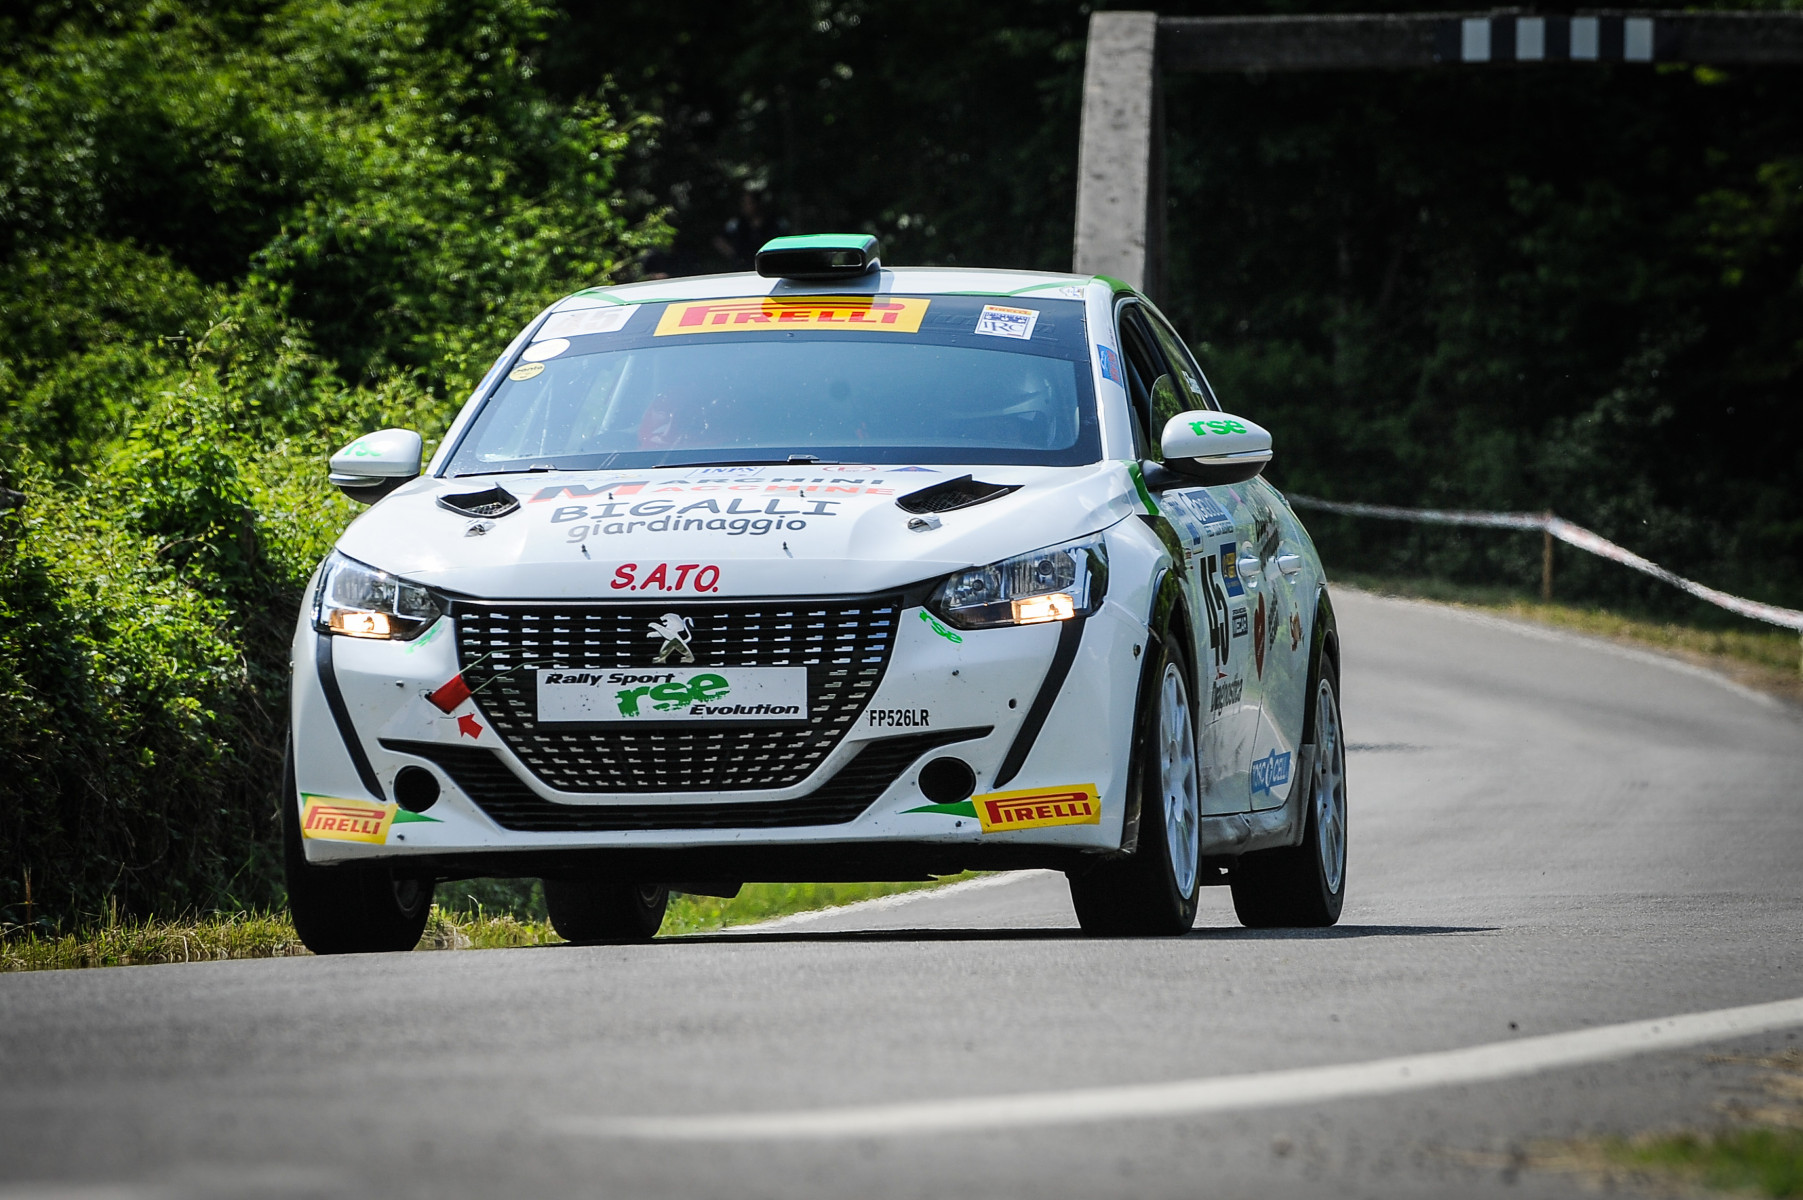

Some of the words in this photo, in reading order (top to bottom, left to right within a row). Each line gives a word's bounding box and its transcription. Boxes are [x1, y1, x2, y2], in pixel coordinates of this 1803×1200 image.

[678, 302, 905, 327] PIRELLI
[1188, 420, 1247, 436] rse
[527, 481, 650, 504] M
[651, 485, 895, 495] ACCHINE
[550, 498, 842, 524] BIGALLI
[566, 515, 807, 544] giardinaggio
[1200, 554, 1229, 667] 45
[545, 673, 603, 686] Rally
[607, 673, 675, 686] Sport
[614, 673, 731, 718] rse
[689, 703, 800, 716] Evolution
[869, 708, 930, 728] FP526LR
[304, 805, 386, 835] PIRELLI
[984, 791, 1092, 825] PIRELLI
